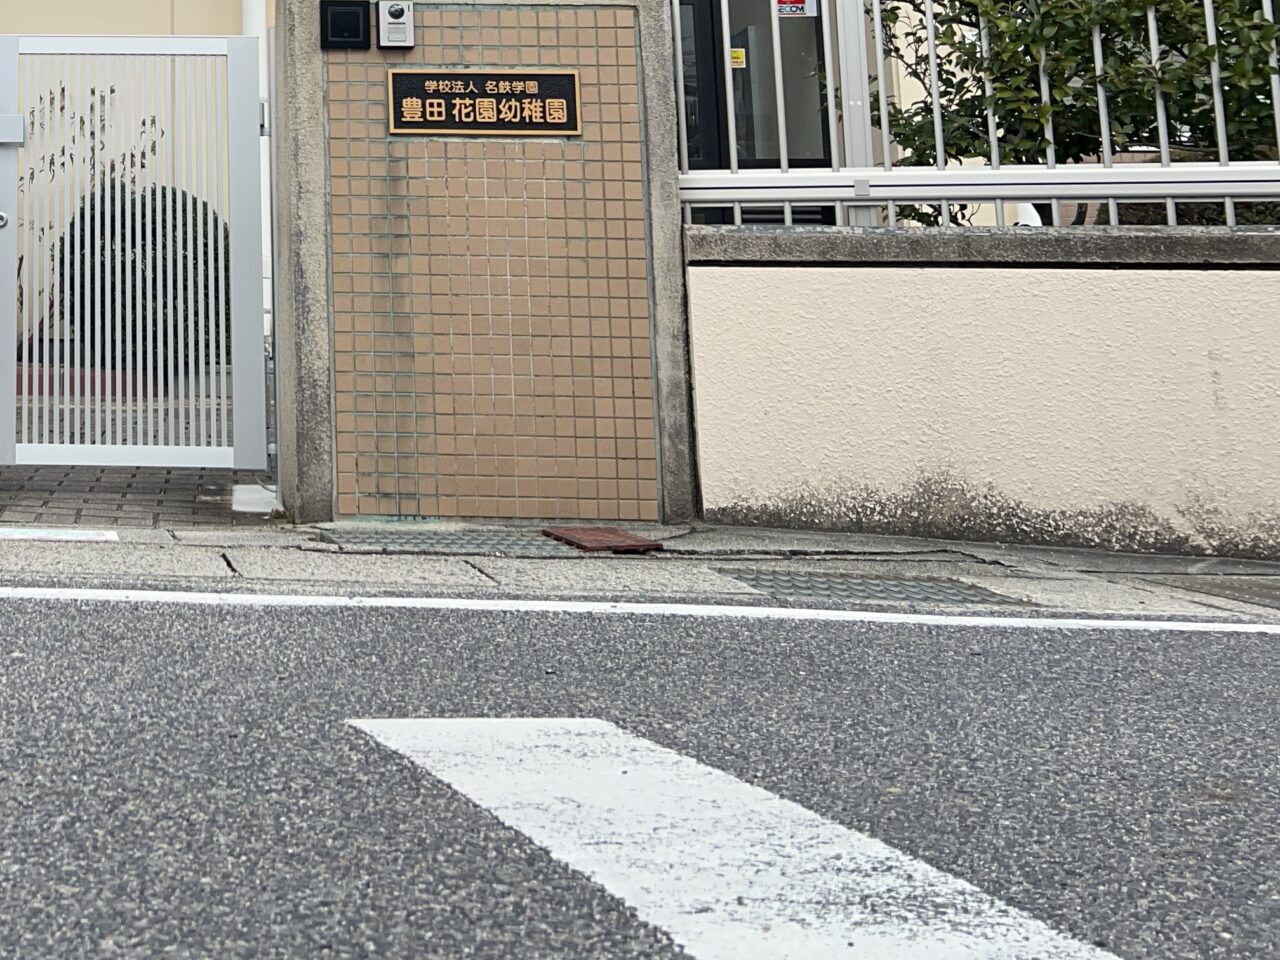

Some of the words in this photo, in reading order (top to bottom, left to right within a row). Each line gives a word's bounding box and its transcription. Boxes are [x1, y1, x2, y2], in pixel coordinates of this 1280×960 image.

[424, 80, 478, 94] 学校法人
[485, 81, 538, 94] 名鉄学園
